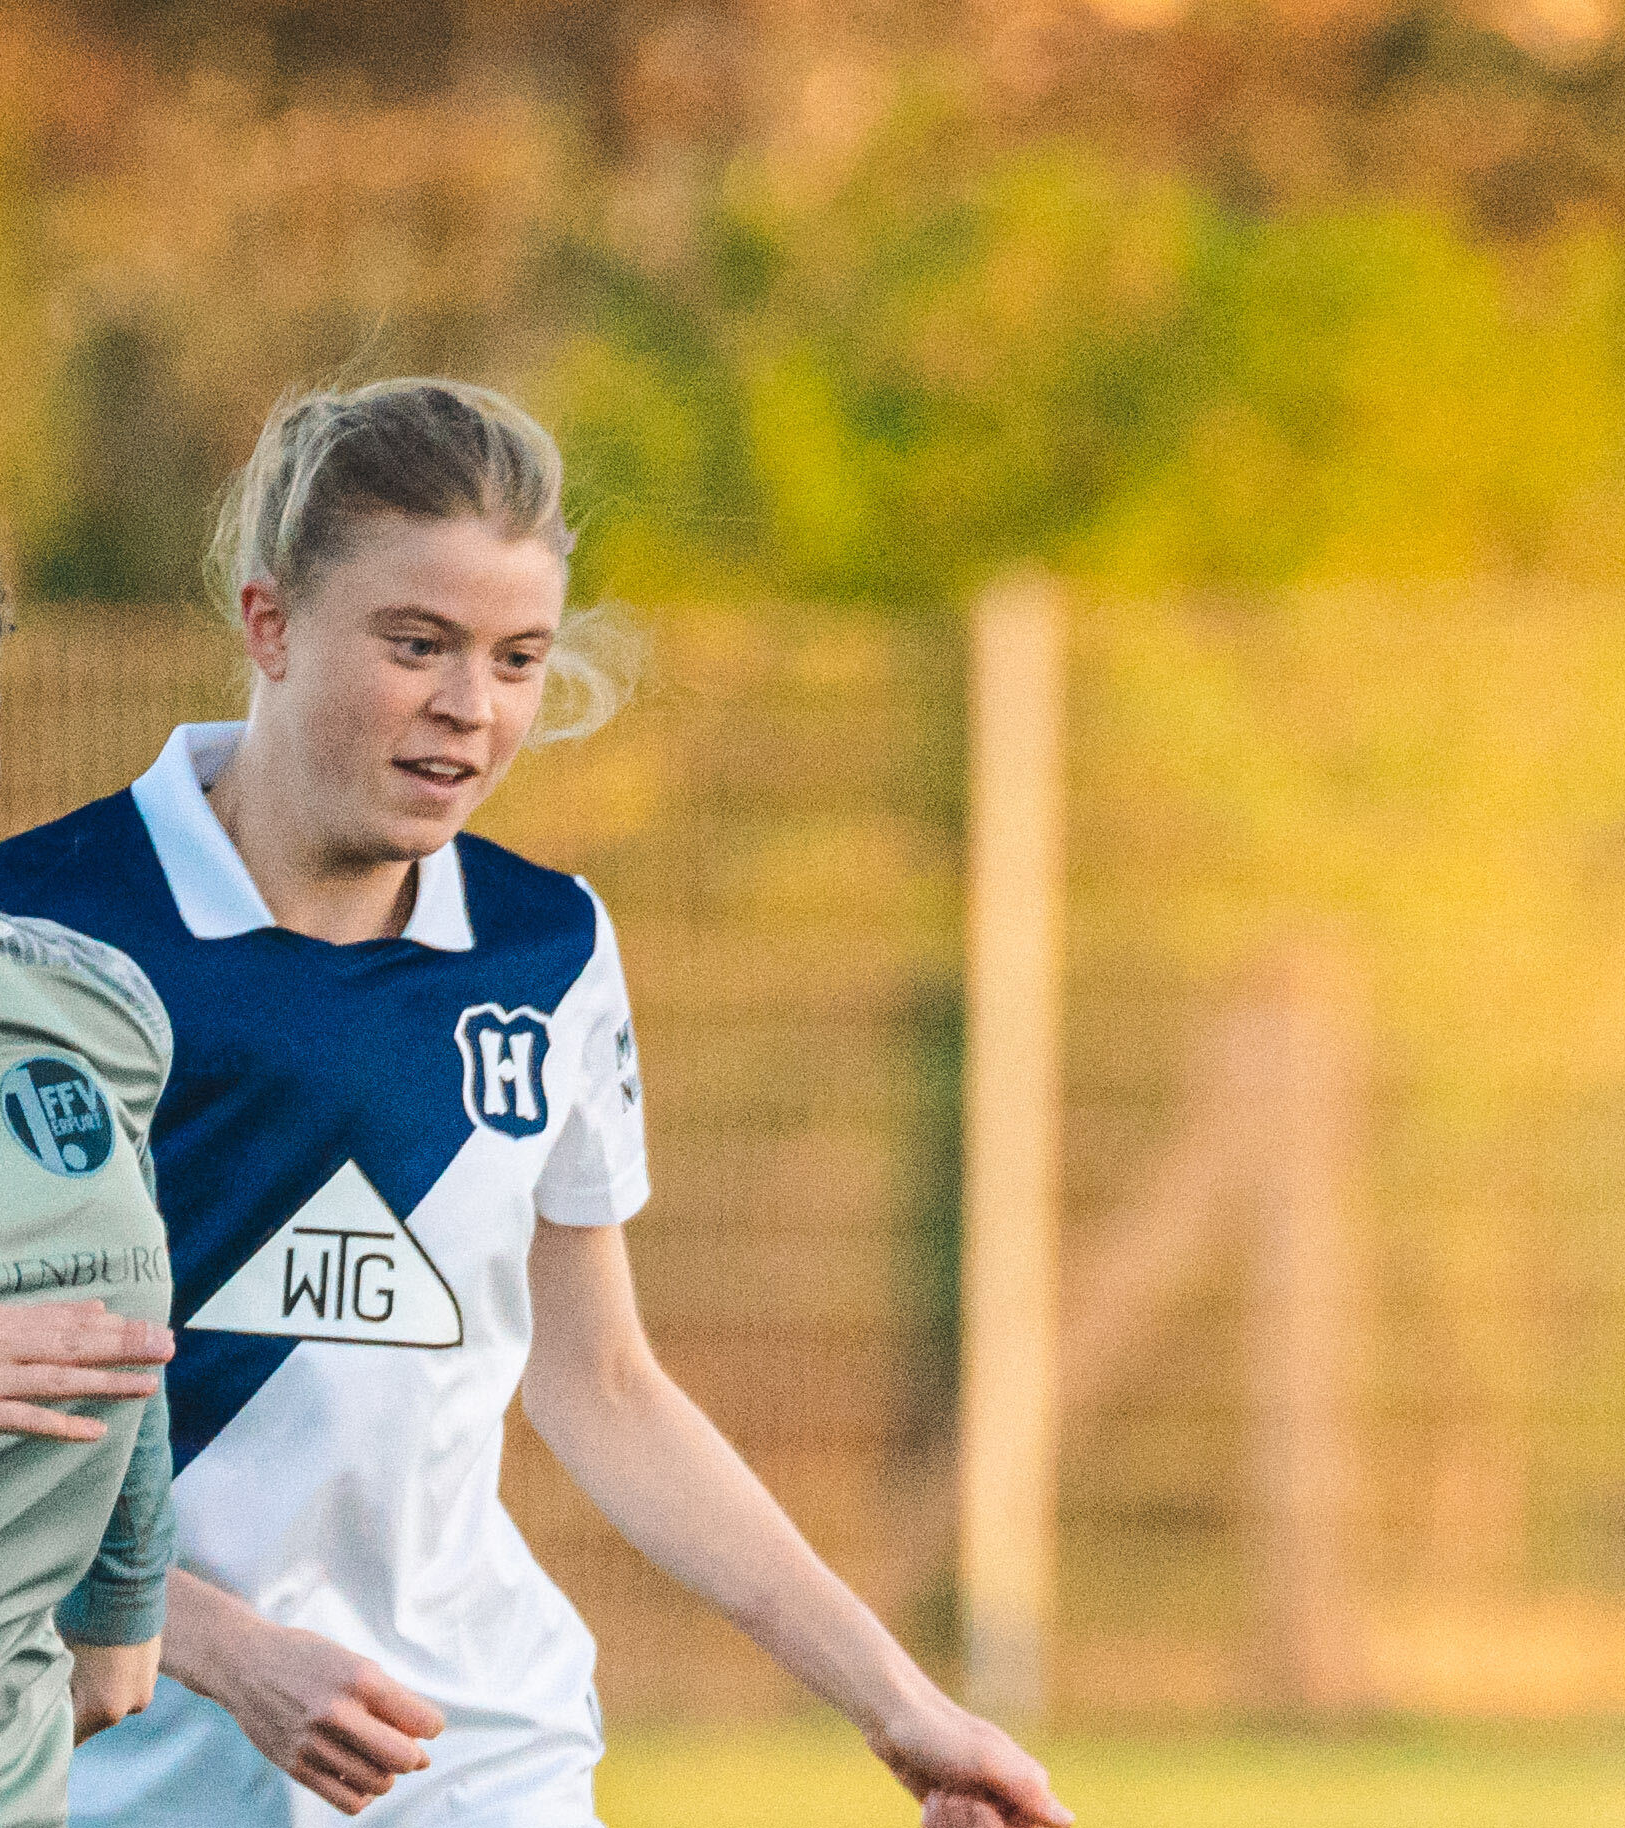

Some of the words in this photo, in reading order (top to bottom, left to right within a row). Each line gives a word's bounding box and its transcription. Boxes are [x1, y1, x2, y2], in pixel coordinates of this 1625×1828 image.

[37, 1080, 97, 1119] FFV
[479, 1028, 541, 1121] H
[282, 1226, 395, 1322] WTG
